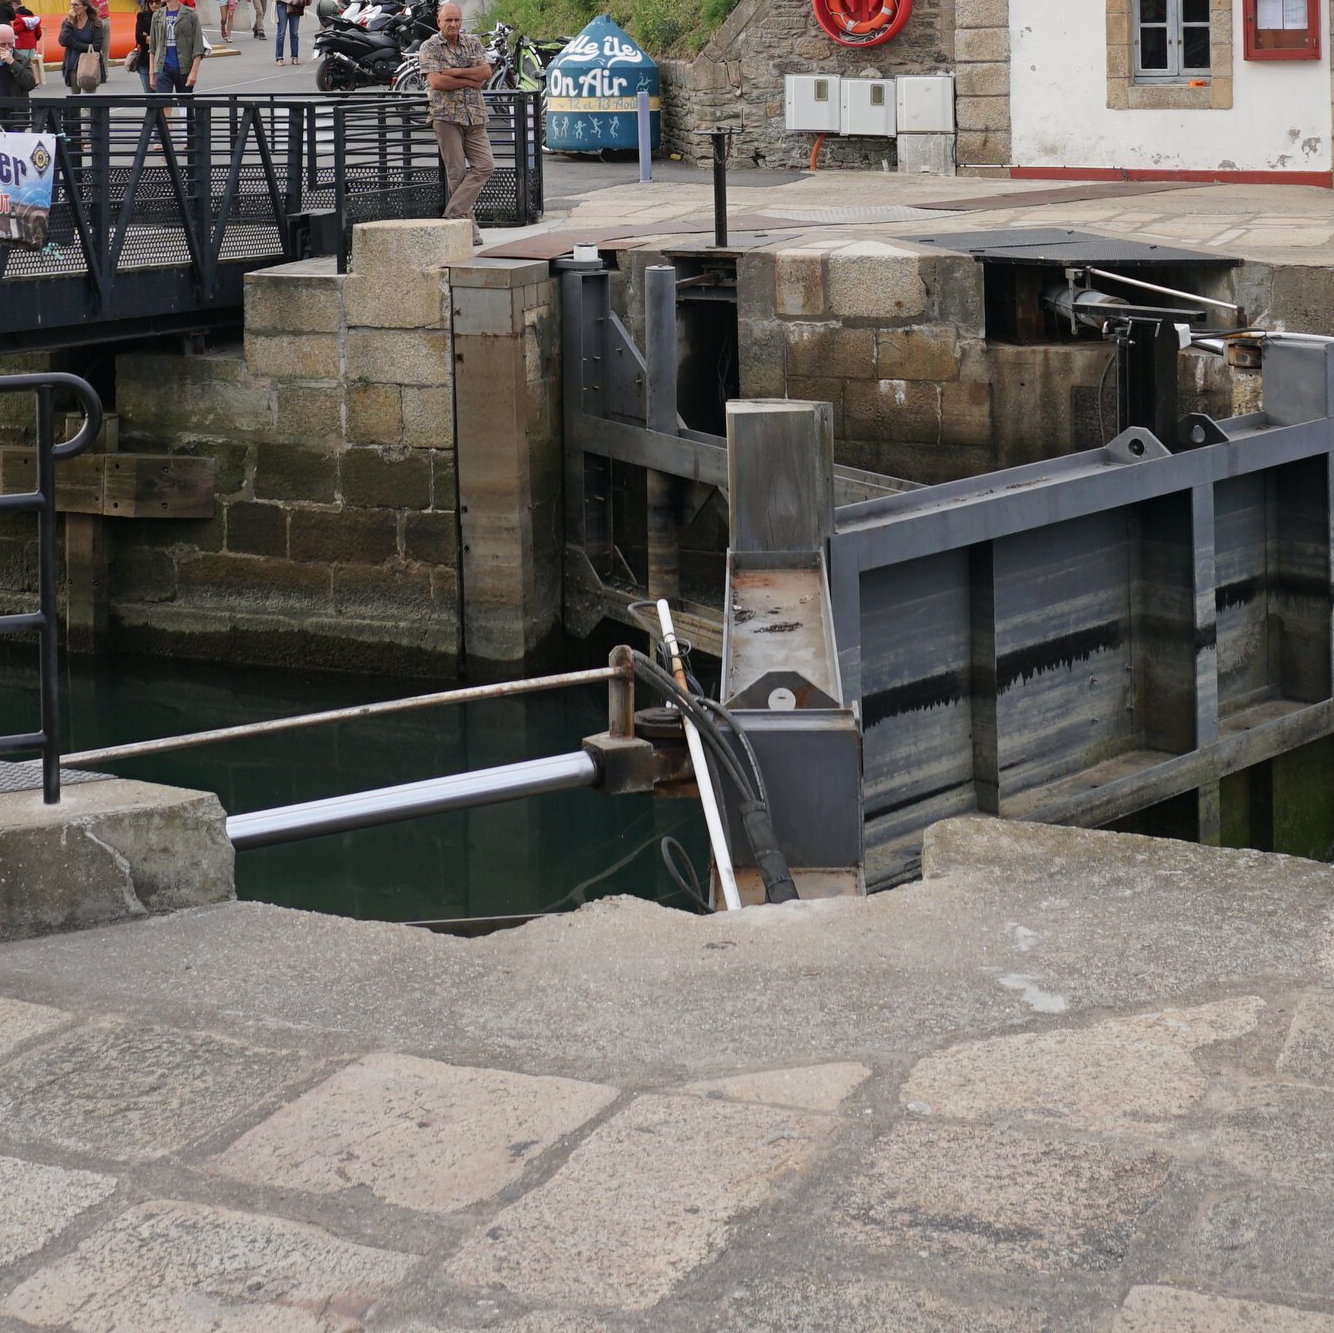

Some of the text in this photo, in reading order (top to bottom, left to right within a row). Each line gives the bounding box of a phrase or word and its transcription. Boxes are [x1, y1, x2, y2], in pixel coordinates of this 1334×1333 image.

[550, 68, 627, 97] On Air
[614, 97, 638, 110] Aoû
